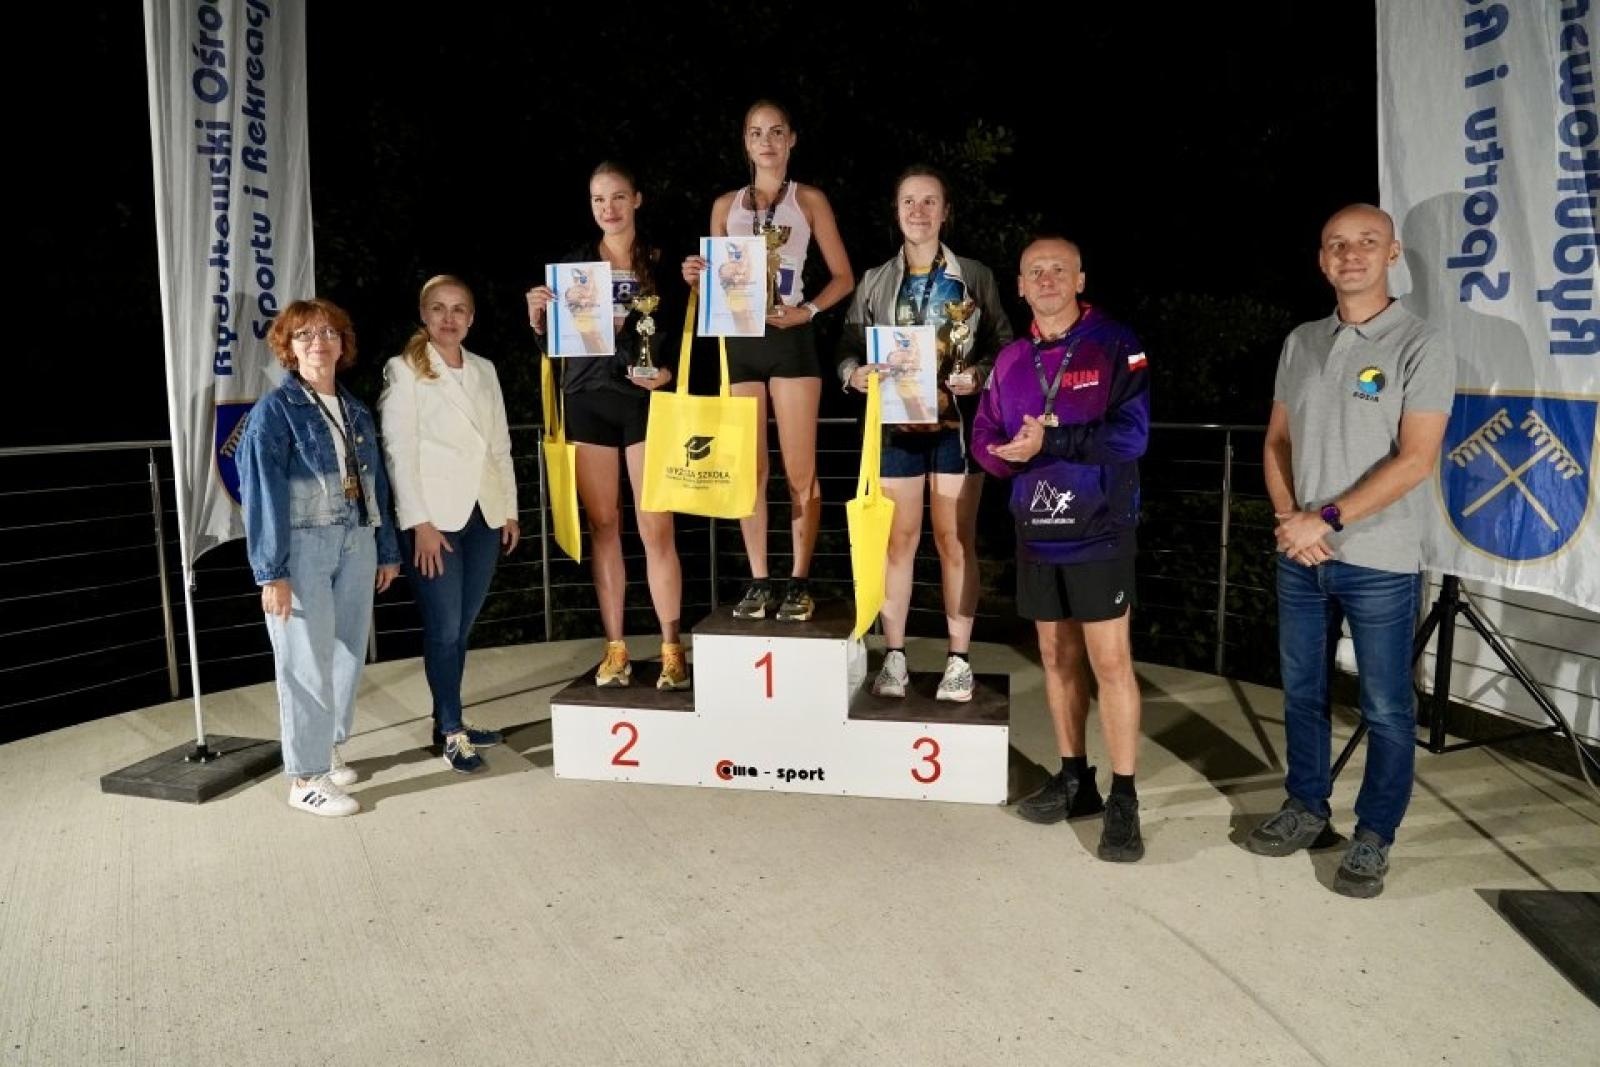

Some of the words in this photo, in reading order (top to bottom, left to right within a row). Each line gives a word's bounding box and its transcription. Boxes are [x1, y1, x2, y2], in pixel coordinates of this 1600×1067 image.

[192, 0, 230, 104] Ośro
[243, 185, 269, 199] i
[194, 120, 238, 376] Rydułtowski
[251, 212, 280, 340] Sportu
[1061, 369, 1099, 388] RUN
[754, 651, 773, 699] 1
[610, 721, 640, 768] 2
[911, 736, 941, 784] 3
[777, 767, 825, 783] sport
